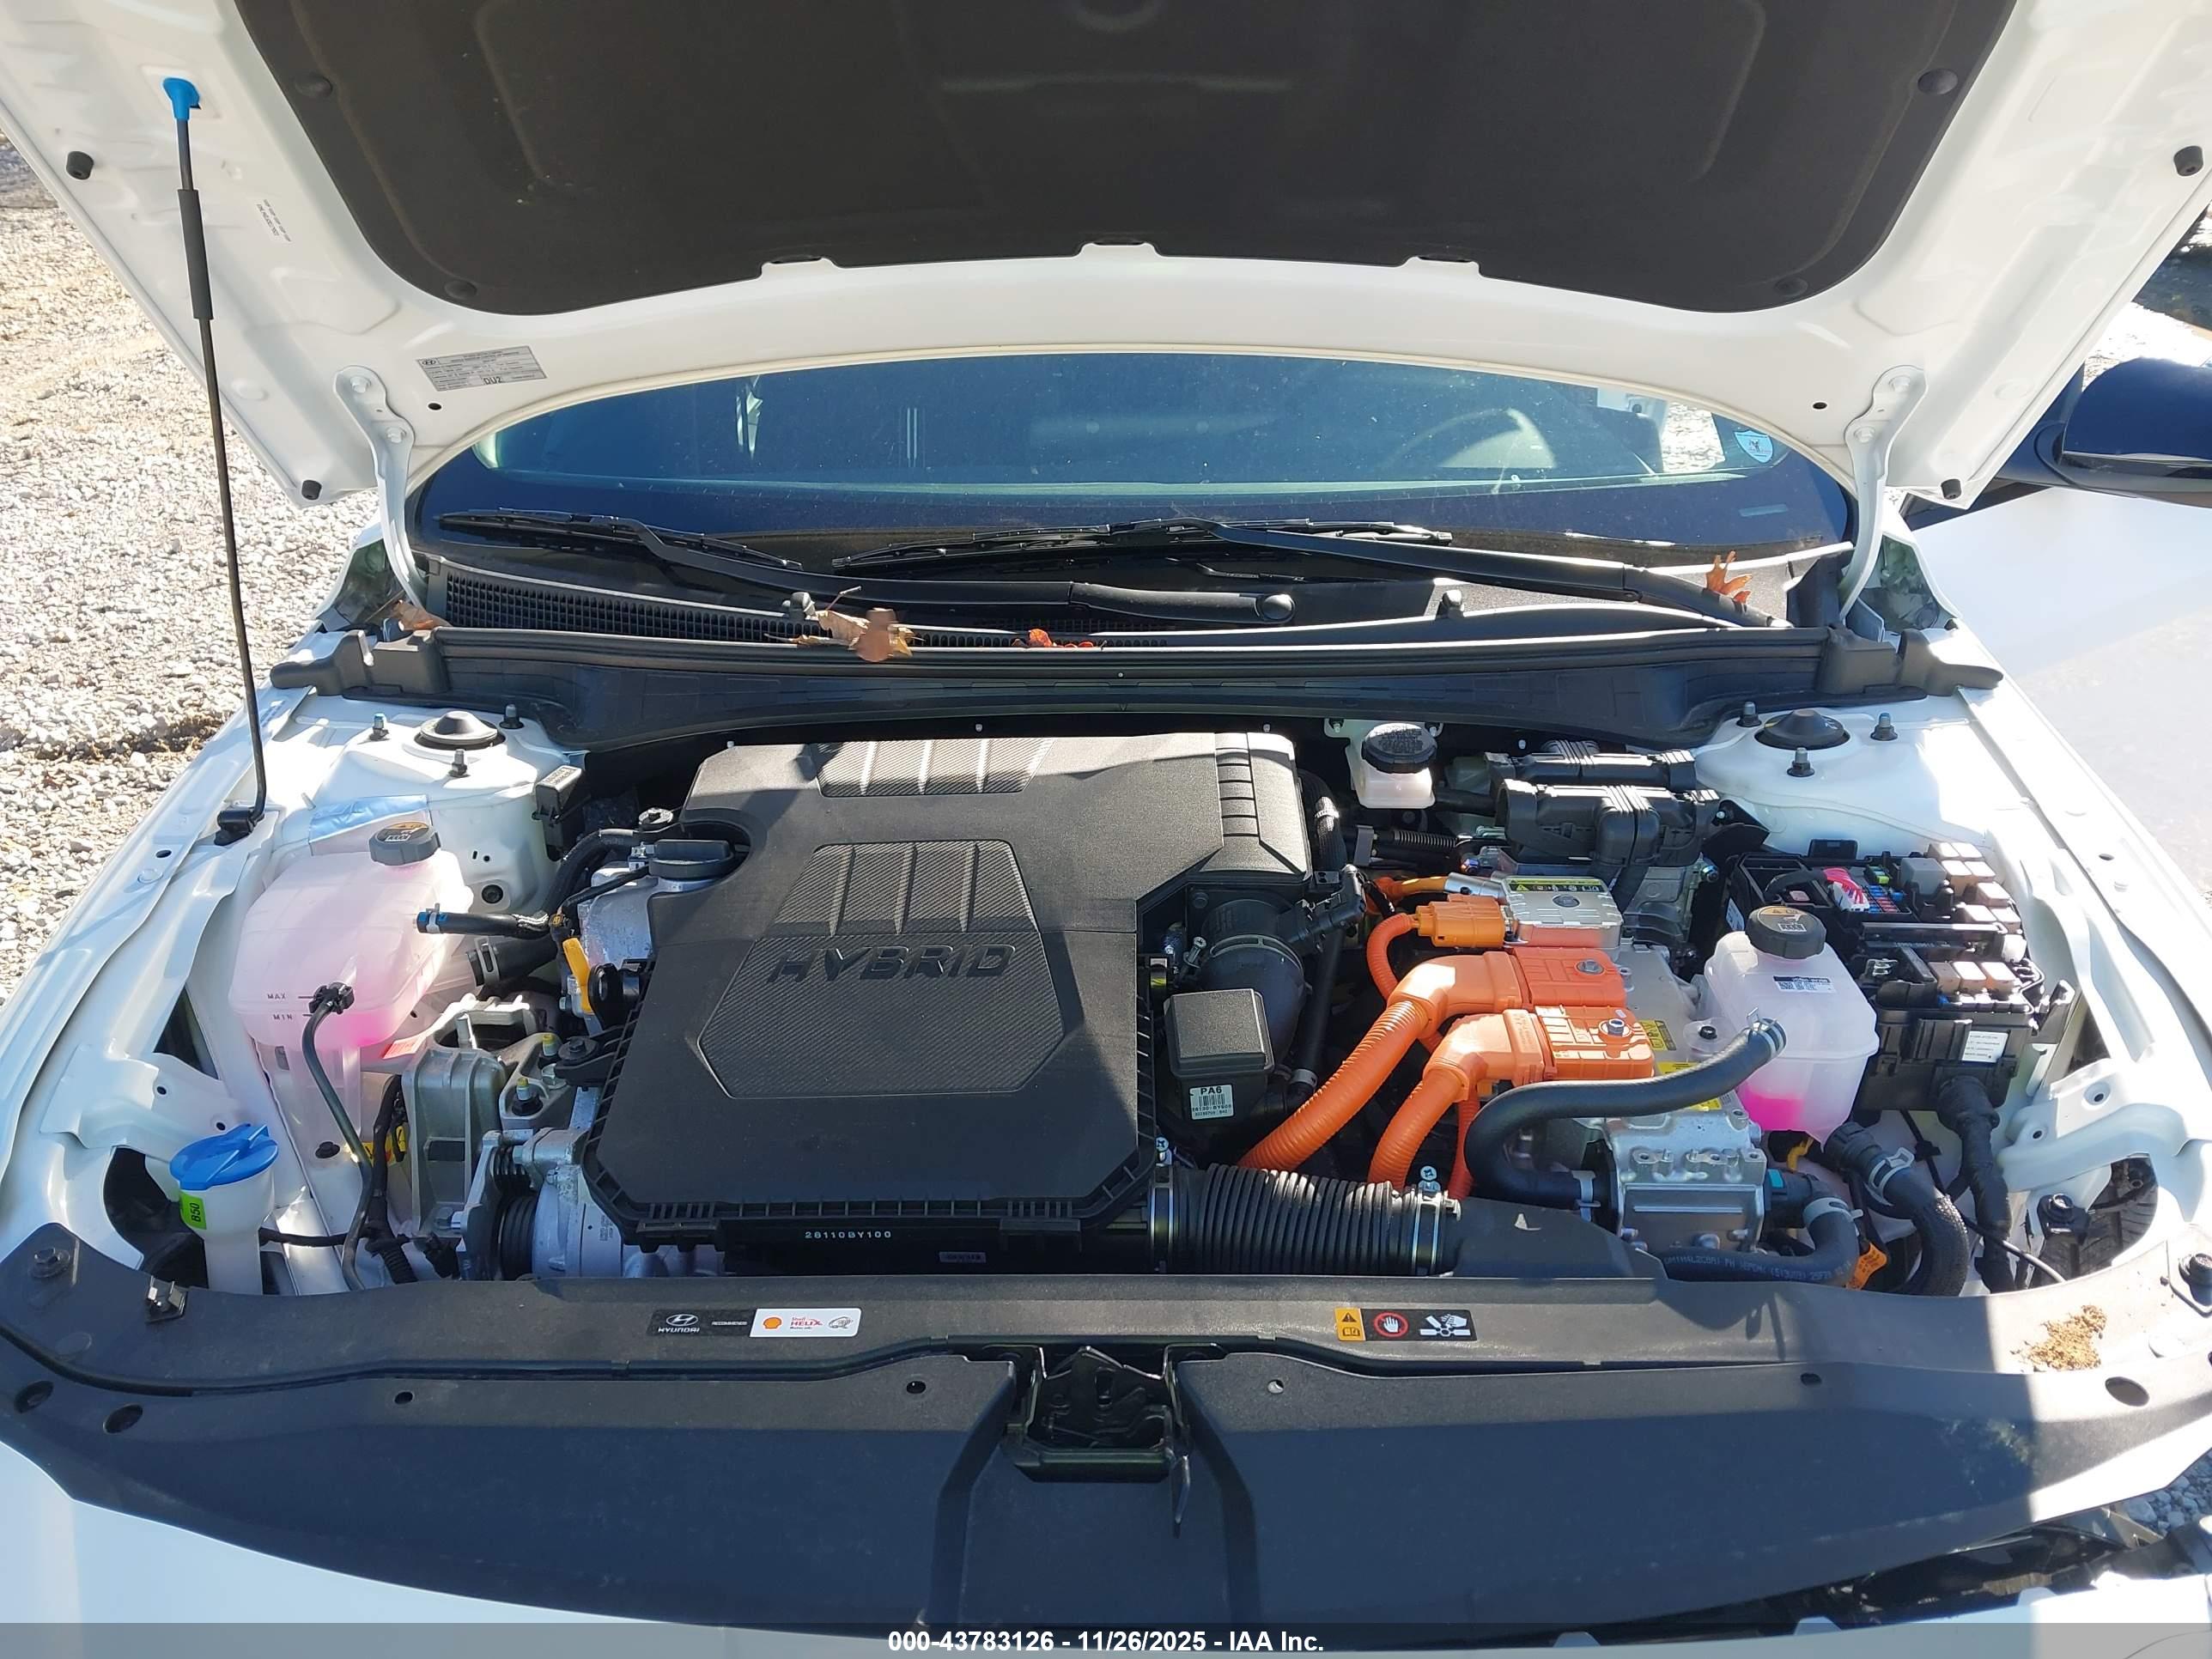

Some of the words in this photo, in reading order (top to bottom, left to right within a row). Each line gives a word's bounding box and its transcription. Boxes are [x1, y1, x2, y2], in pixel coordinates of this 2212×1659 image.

[767, 945, 1016, 982] HYBRID
[1200, 1085, 1223, 1095] PA6
[189, 1202, 202, 1222] 850
[805, 1231, 892, 1239] 28110BY100
[790, 1318, 823, 1327] HELIX
